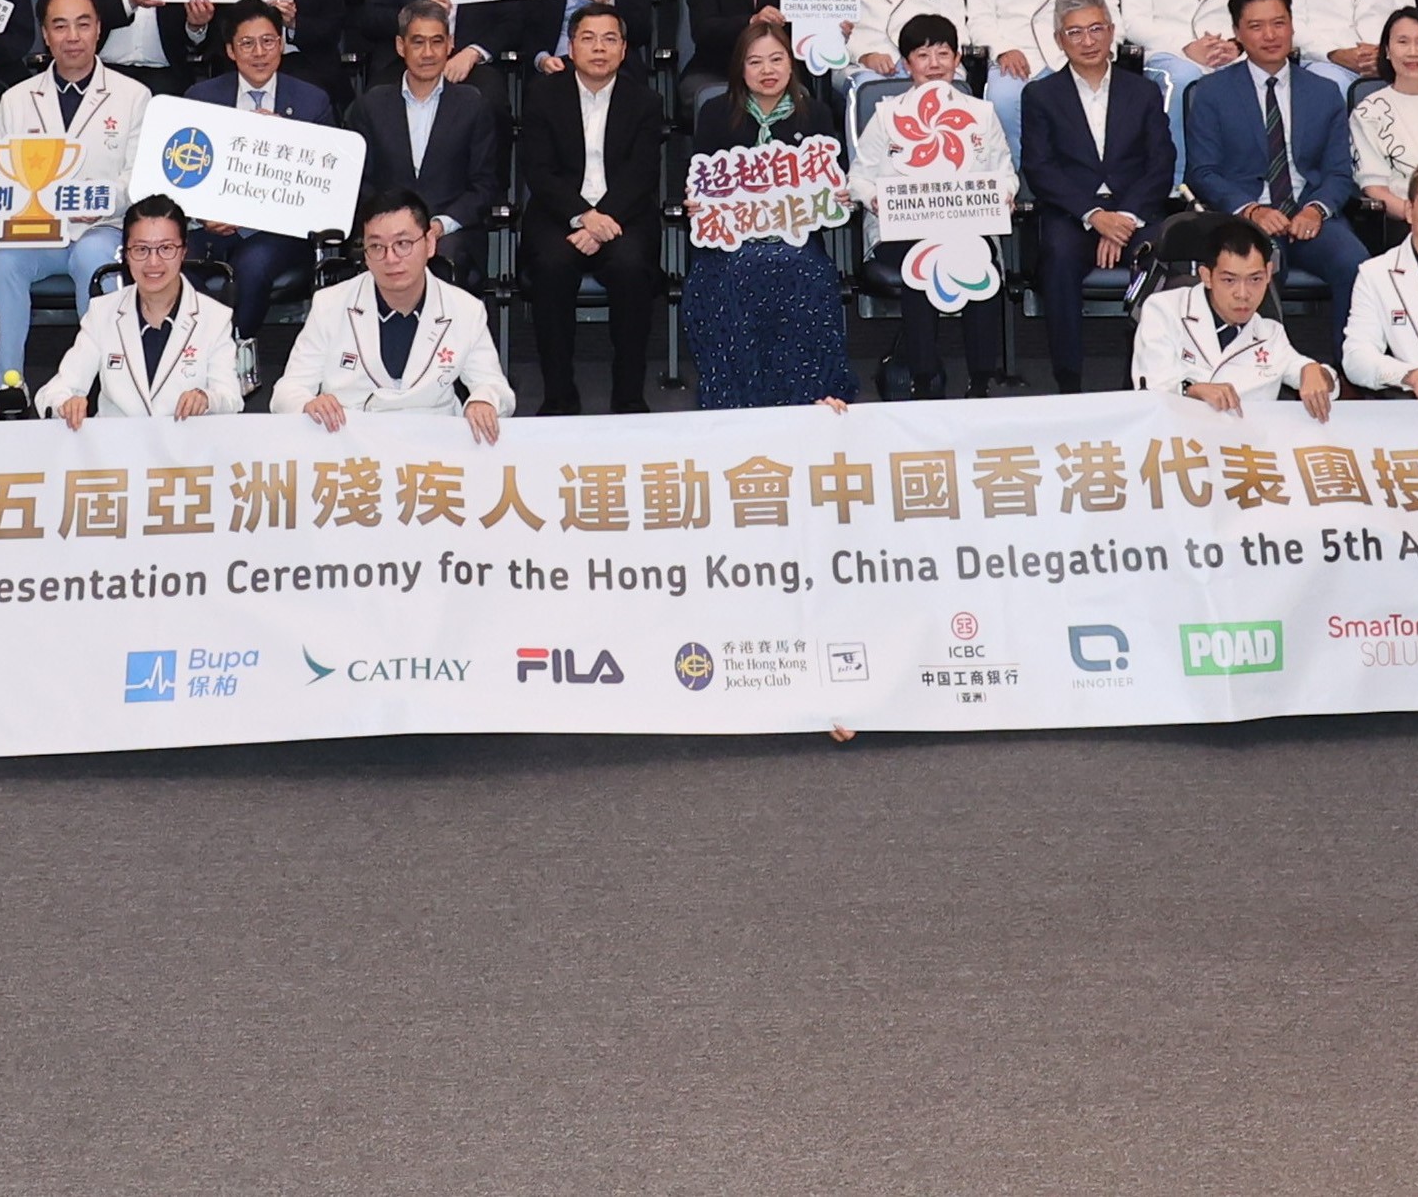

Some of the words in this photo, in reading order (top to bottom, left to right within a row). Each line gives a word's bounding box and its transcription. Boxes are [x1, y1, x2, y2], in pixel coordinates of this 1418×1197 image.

[228, 136, 339, 171] 香港賽馬會
[227, 155, 252, 174] The
[255, 160, 293, 189] Hong
[295, 169, 332, 193] Kong
[693, 142, 841, 198] 超越自我
[54, 185, 110, 211] 佳績
[219, 178, 269, 203] Jockey
[271, 186, 305, 207] Club
[887, 197, 926, 211] CHINA
[928, 194, 963, 208] HONG
[966, 192, 1000, 206] KONG
[696, 187, 845, 245] 成就非凡
[888, 210, 945, 222] PARALYMPIC
[947, 207, 1001, 219] COMMITTEE
[226, 553, 423, 596] Ceremony
[438, 549, 494, 585] for
[507, 557, 570, 591] the
[587, 558, 688, 597] Hong
[705, 553, 815, 593] Kong,
[831, 549, 940, 584] China
[955, 538, 1169, 584] Delegation
[1184, 536, 1225, 569] to
[1239, 531, 1305, 566] the
[1320, 527, 1383, 564] 5th
[721, 638, 808, 655] 香港賽馬會
[948, 645, 986, 659] ICBC
[1187, 628, 1277, 669] POAD
[187, 647, 260, 673] Bupa
[346, 657, 473, 682] CATHAY
[515, 647, 626, 685] FILA
[723, 658, 744, 671] The
[746, 657, 777, 673] Hong
[778, 656, 808, 673] Kong
[187, 675, 239, 699] 保柏
[724, 674, 762, 691] Jockey
[764, 673, 792, 688] Club
[921, 669, 1019, 687] 中国工商银行
[1071, 676, 1135, 689] INNOTIER
